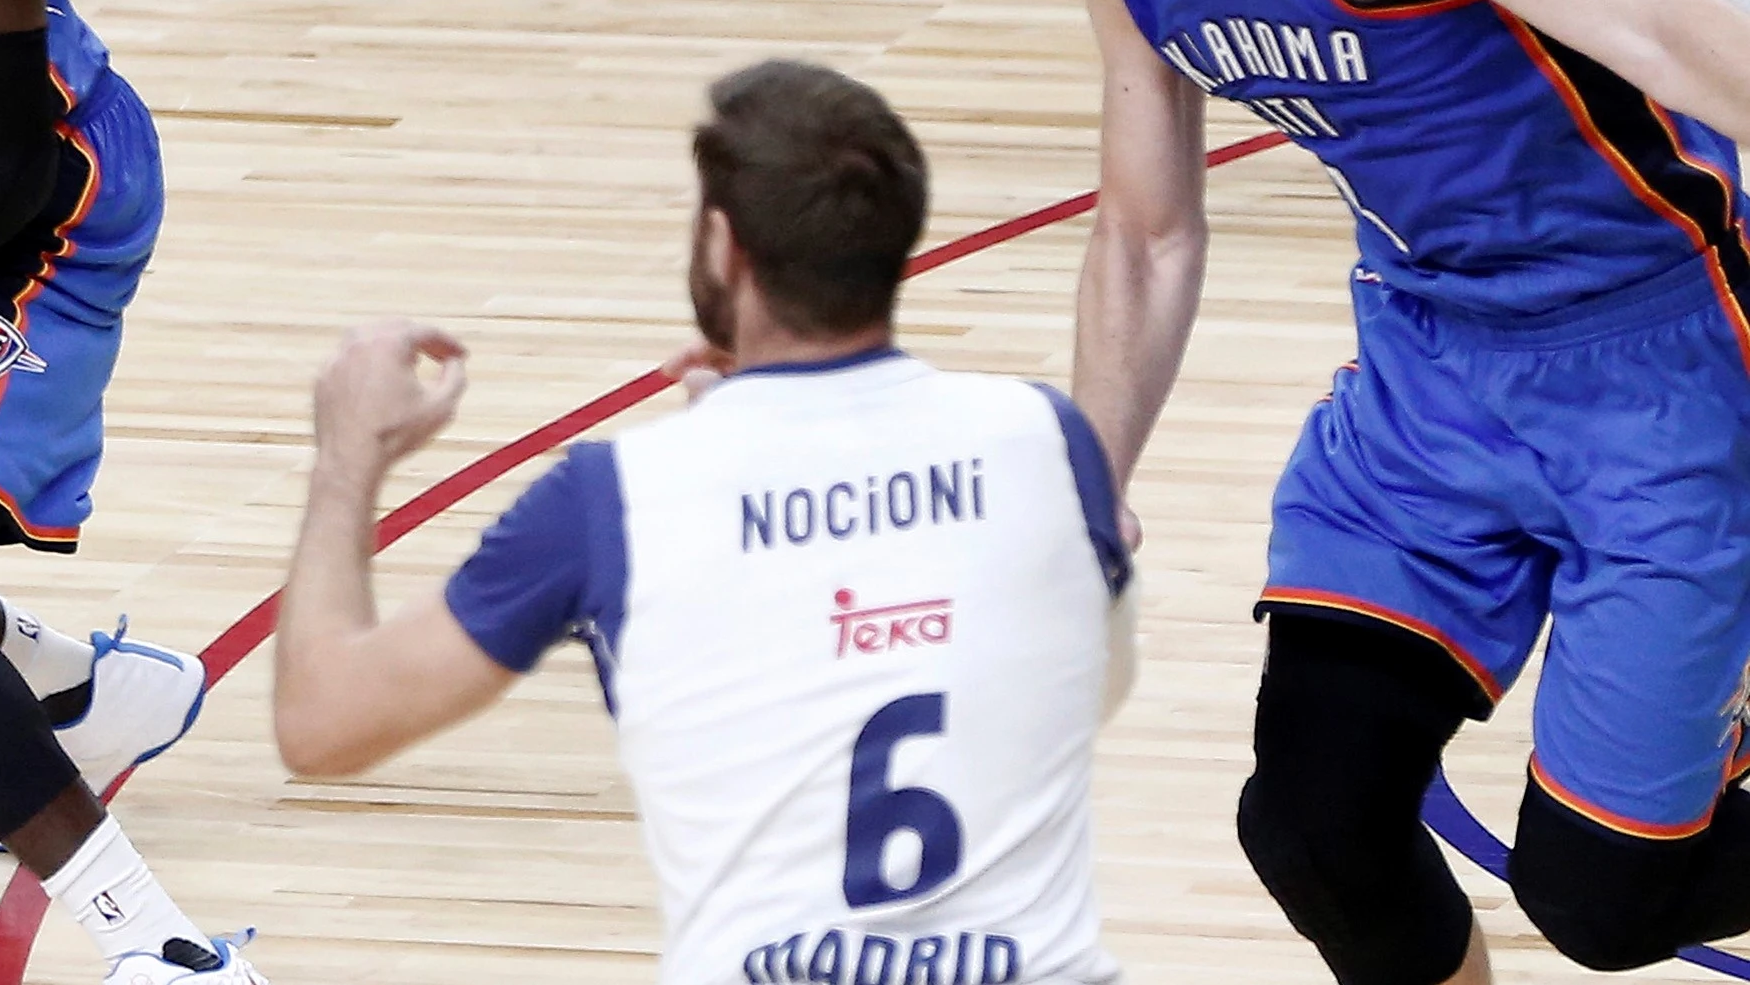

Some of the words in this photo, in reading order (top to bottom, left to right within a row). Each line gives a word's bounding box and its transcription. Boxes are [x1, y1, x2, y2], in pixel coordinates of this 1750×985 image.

[1251, 96, 1340, 138] ITY
[842, 691, 966, 910] 6
[743, 927, 1025, 985] MADRID
